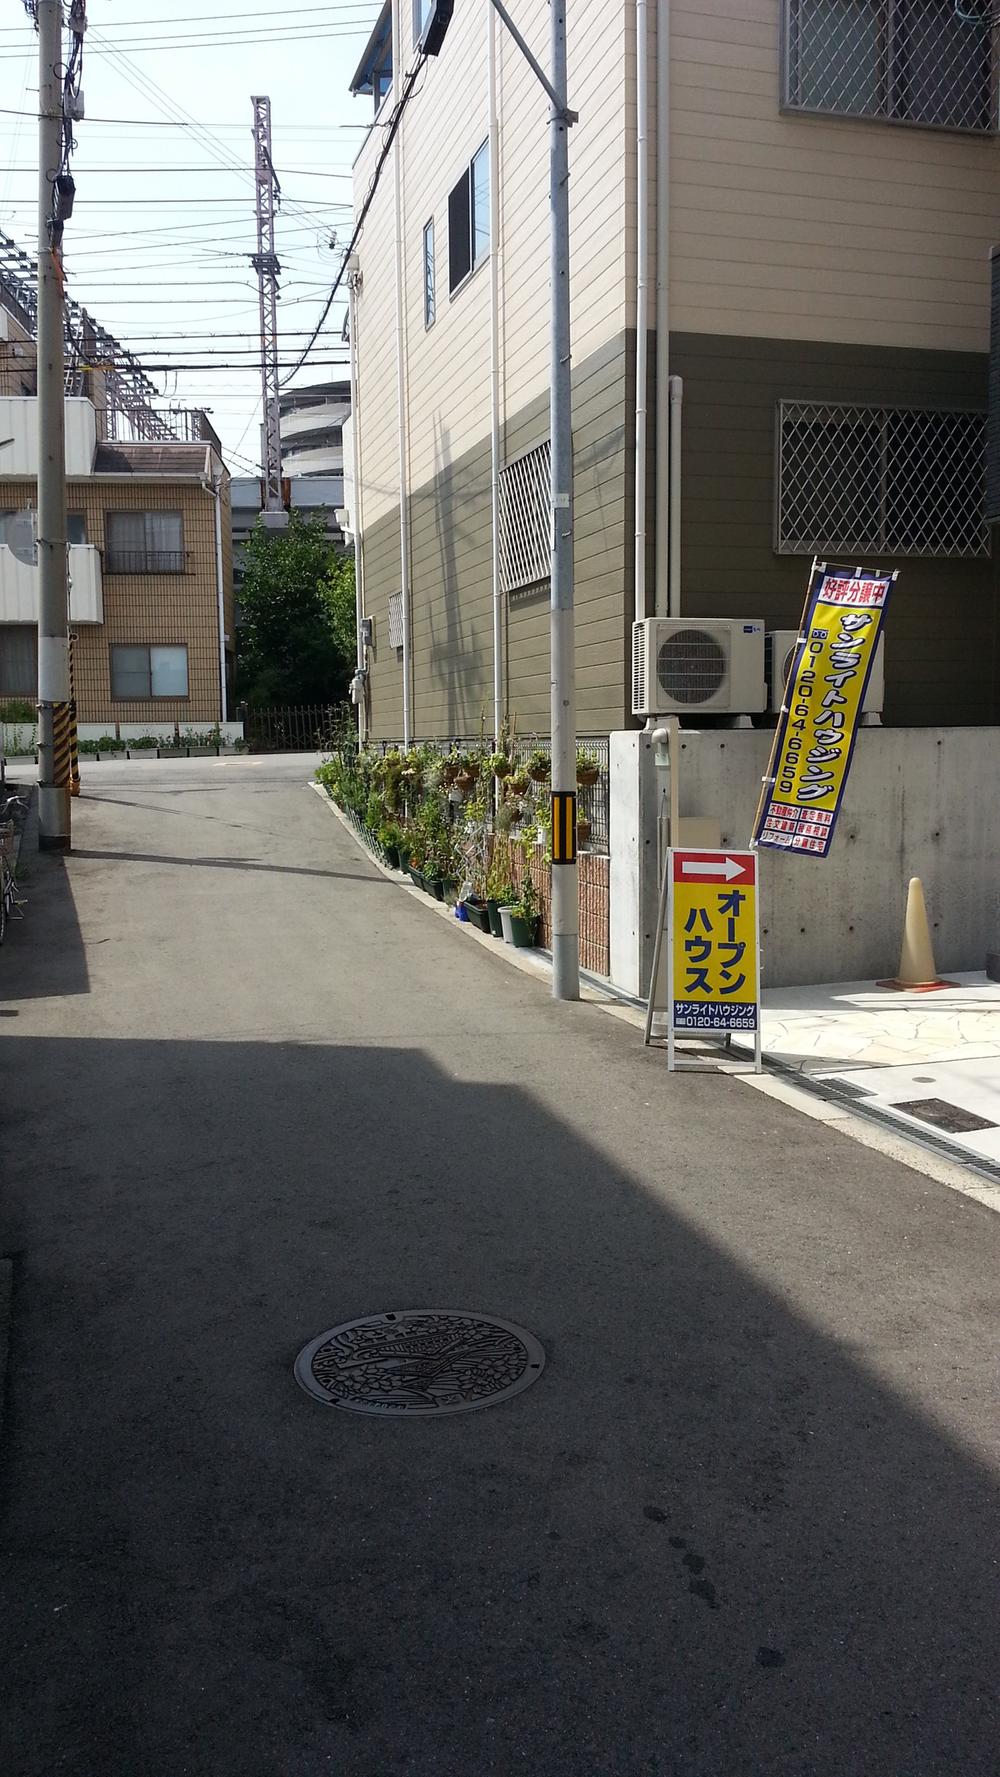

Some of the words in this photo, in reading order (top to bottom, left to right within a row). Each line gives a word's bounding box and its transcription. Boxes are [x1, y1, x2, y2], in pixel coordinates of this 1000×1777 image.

[822, 577, 885, 605] 好評分譲中
[779, 641, 823, 794] 0120-64-6659
[796, 613, 873, 802] サンライトハウジング
[684, 908, 713, 994] ハウス
[717, 889, 746, 995] オープン
[676, 1002, 755, 1017] サンライトハウジング
[686, 1016, 755, 1029] 0120-64-6659
